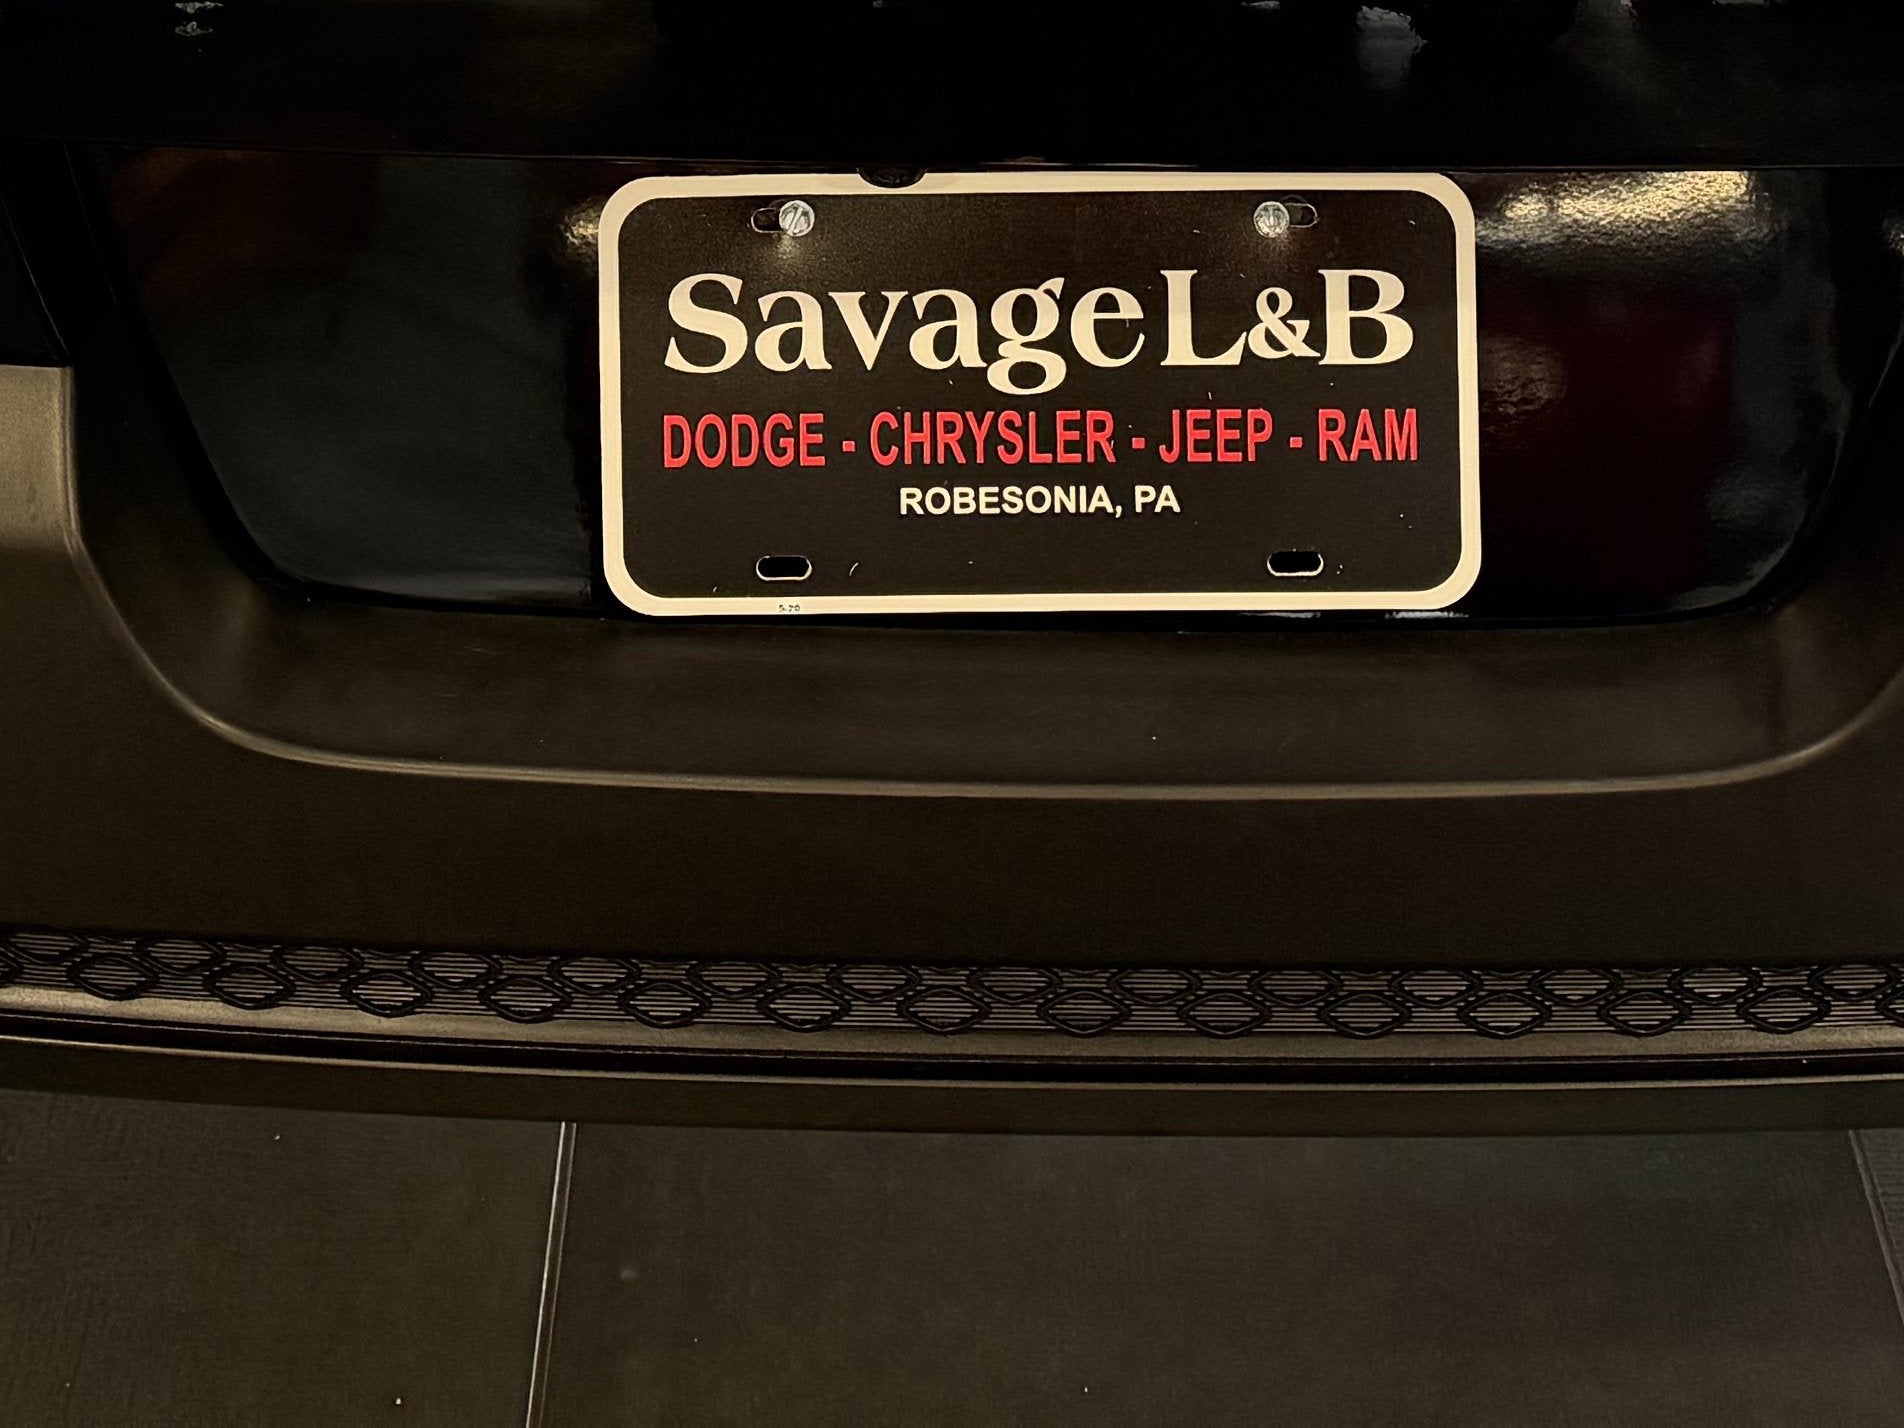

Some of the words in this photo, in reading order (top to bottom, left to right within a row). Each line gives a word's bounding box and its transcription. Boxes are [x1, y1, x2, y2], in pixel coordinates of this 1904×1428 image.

[663, 272, 1146, 396] Savage
[1160, 269, 1415, 366] L&B
[662, 412, 827, 469] DODGE
[870, 409, 1116, 466] CHRYSLER
[1158, 407, 1274, 464] JEEP
[1318, 407, 1419, 462] RAM
[899, 484, 1123, 519] ROBESONIA,
[1134, 483, 1181, 513] PA
